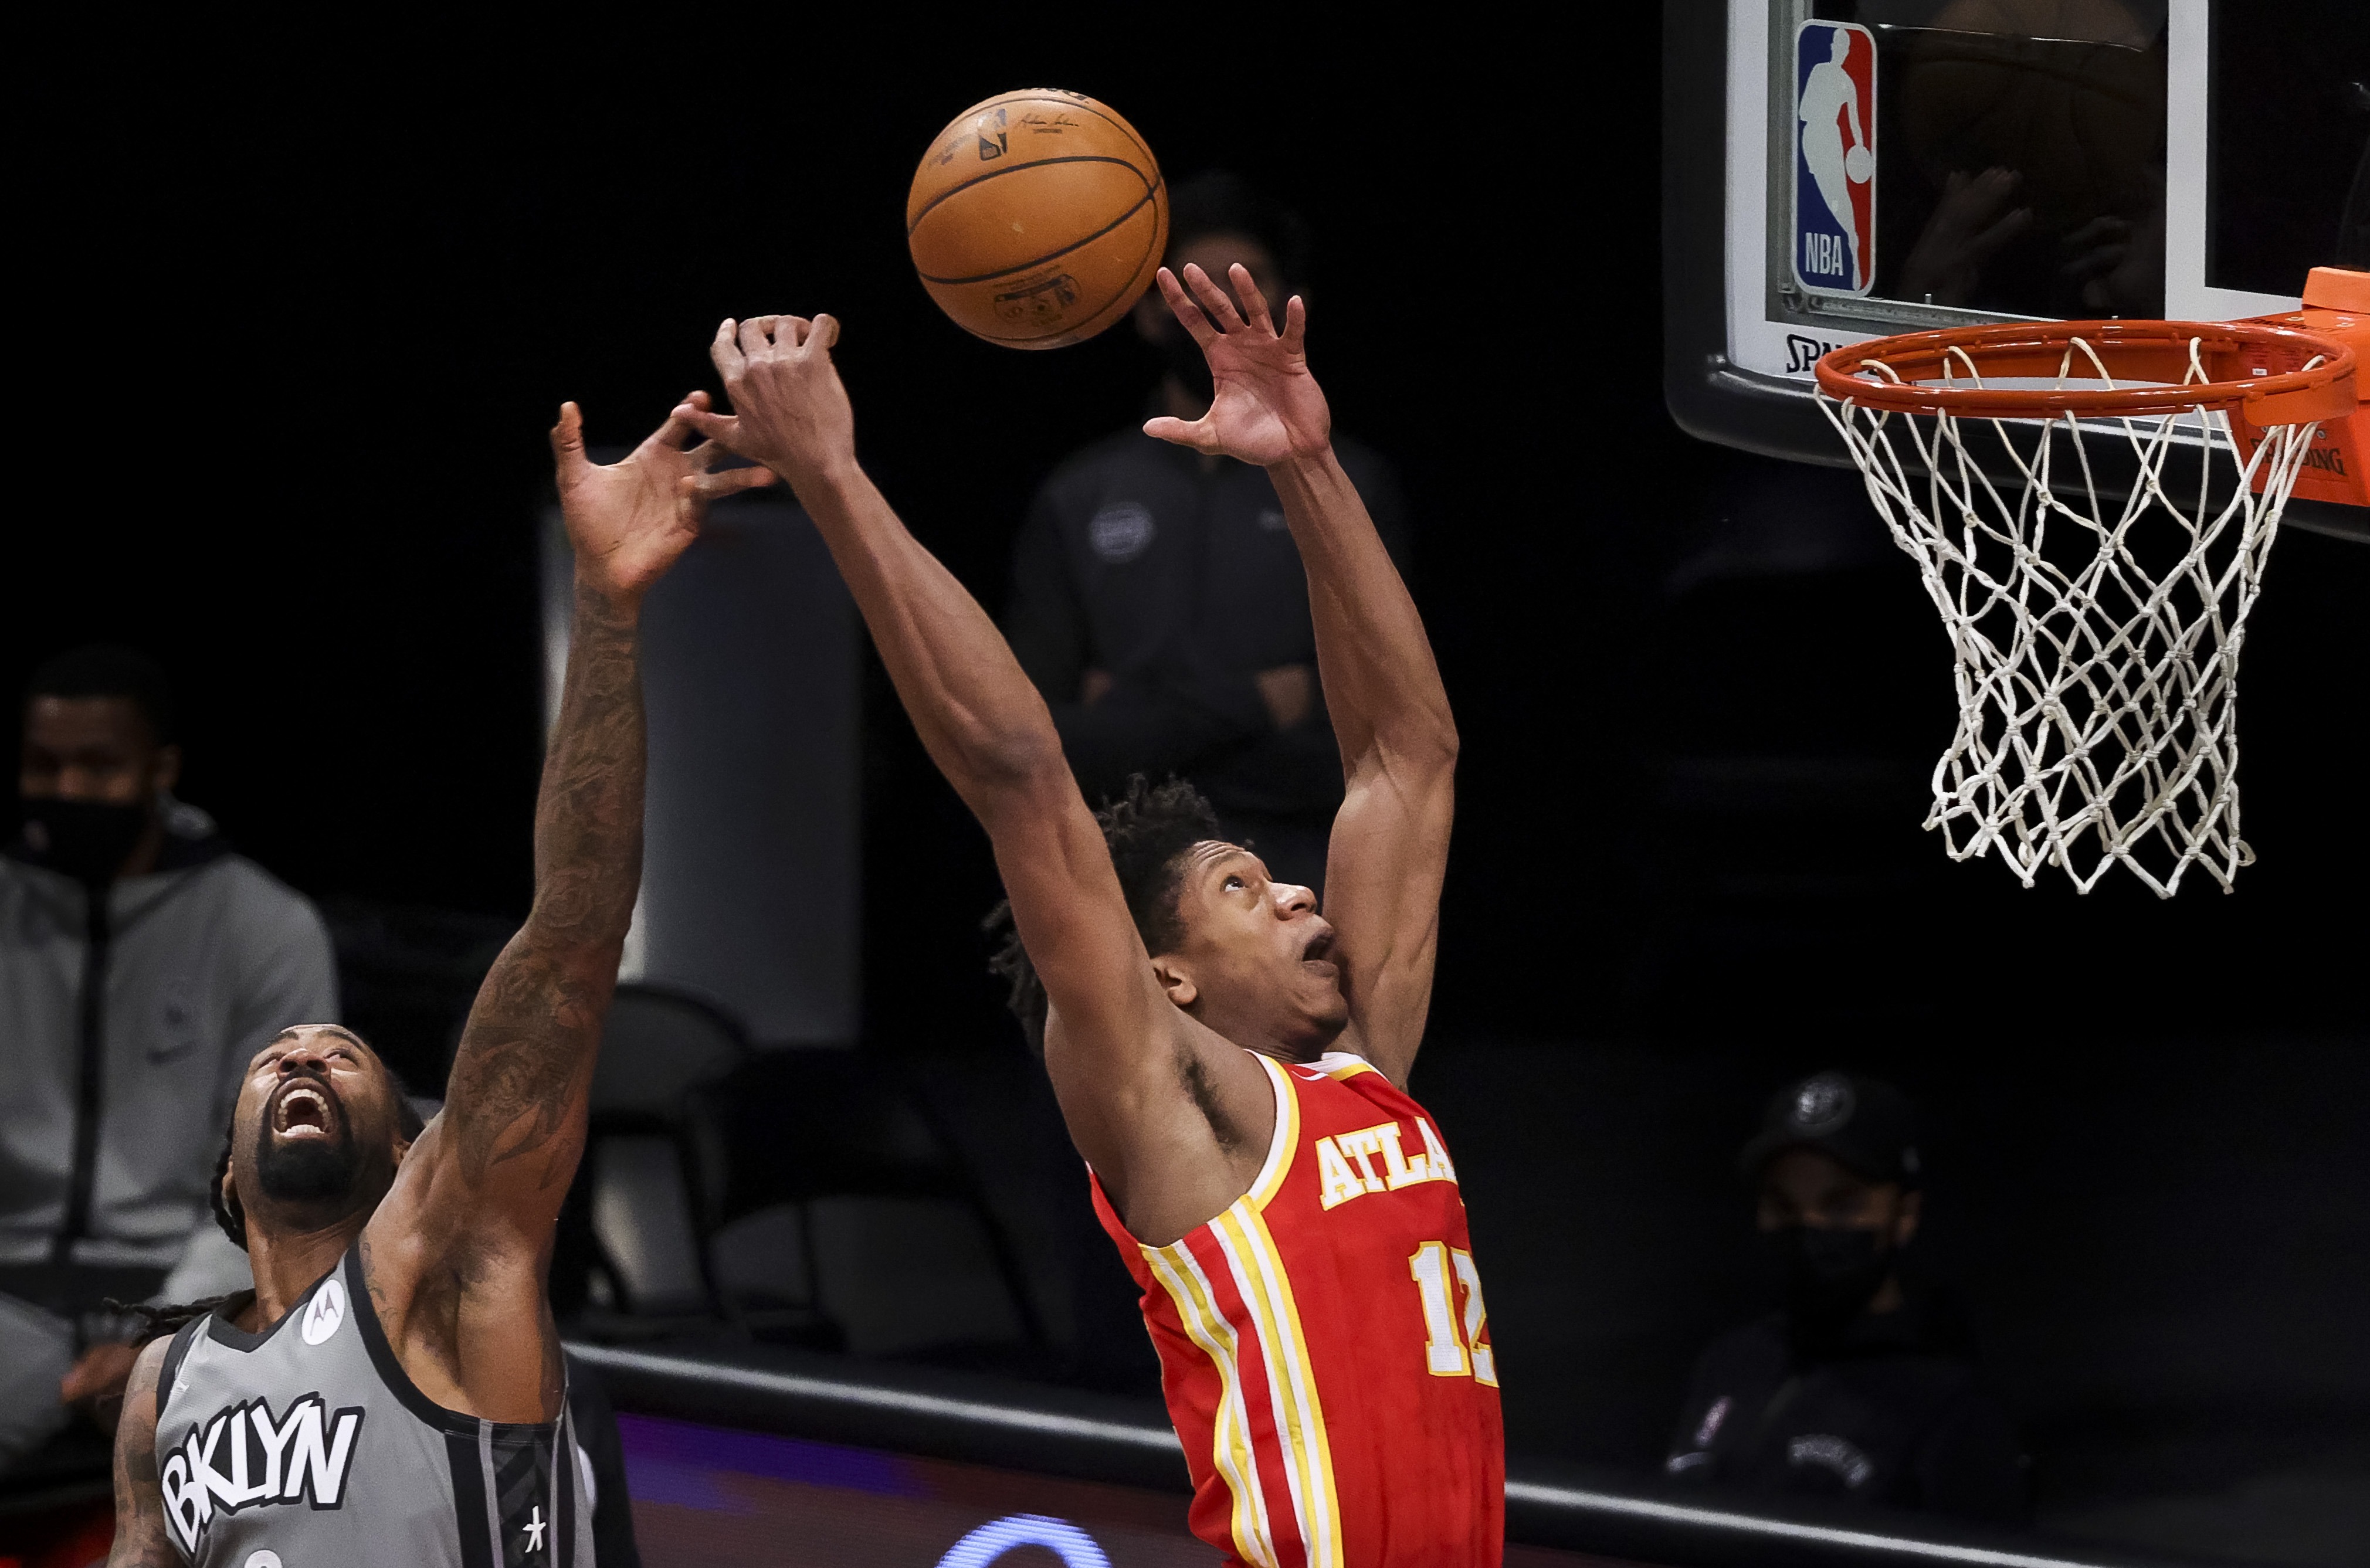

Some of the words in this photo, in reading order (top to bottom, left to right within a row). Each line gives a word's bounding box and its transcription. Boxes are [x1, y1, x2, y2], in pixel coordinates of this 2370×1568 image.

[1806, 232, 1843, 276] NBA
[1408, 1240, 1500, 1388] 12
[160, 1393, 364, 1556] BKLYN
